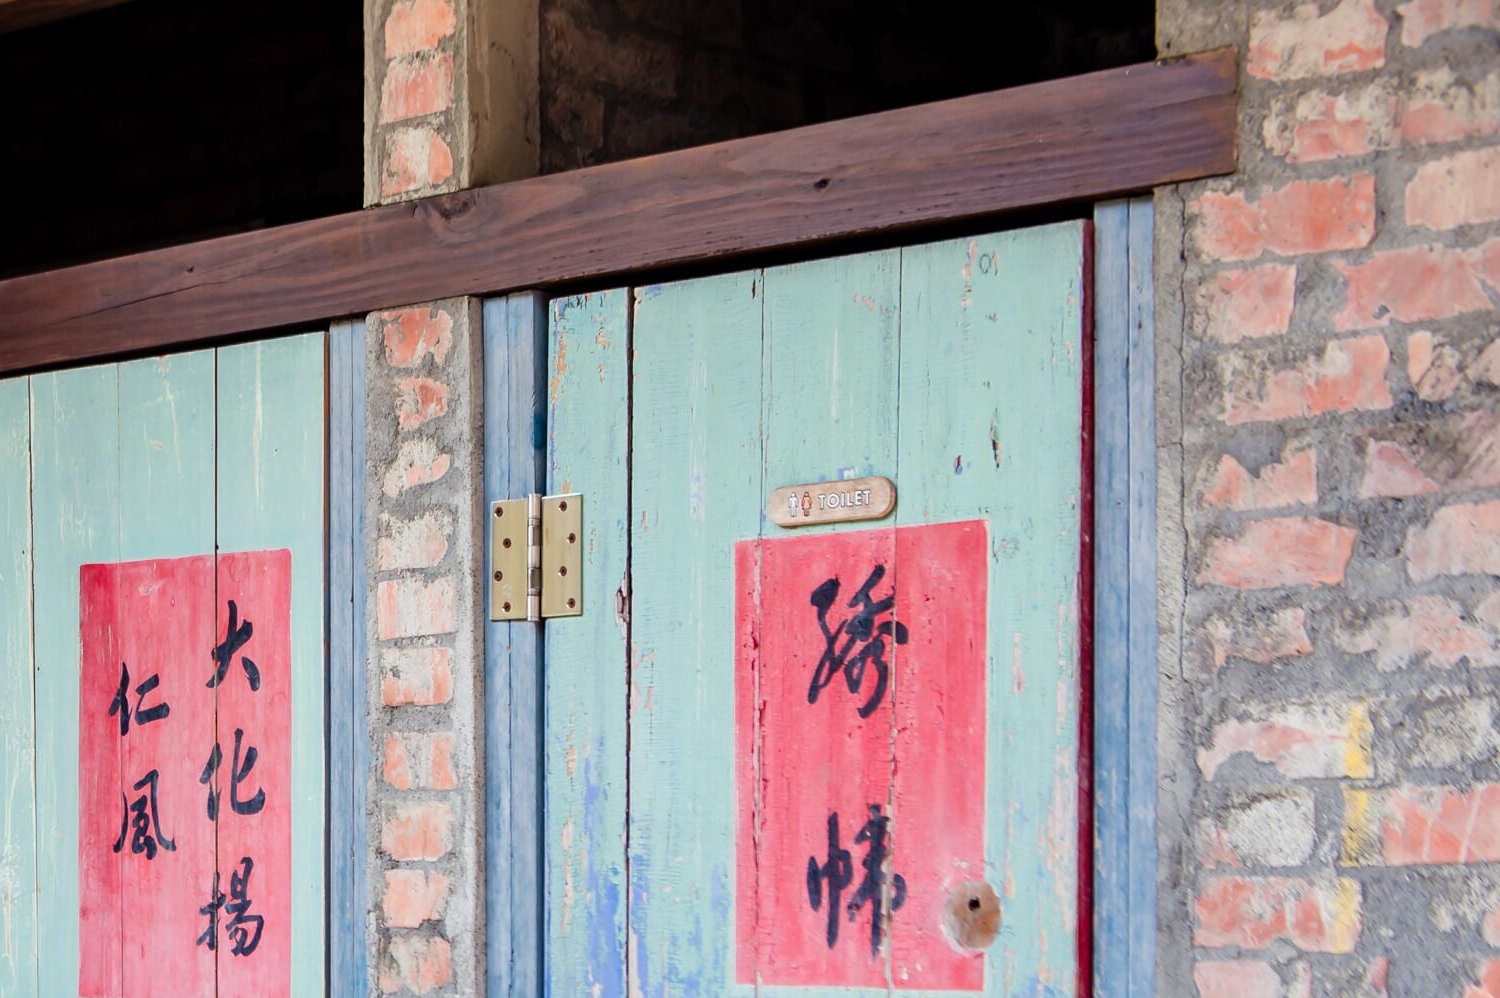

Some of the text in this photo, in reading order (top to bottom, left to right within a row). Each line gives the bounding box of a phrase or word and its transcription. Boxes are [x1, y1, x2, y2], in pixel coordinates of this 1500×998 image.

[818, 490, 871, 510] TOILET
[108, 661, 176, 860] 仁風
[196, 600, 266, 957] 大化揚
